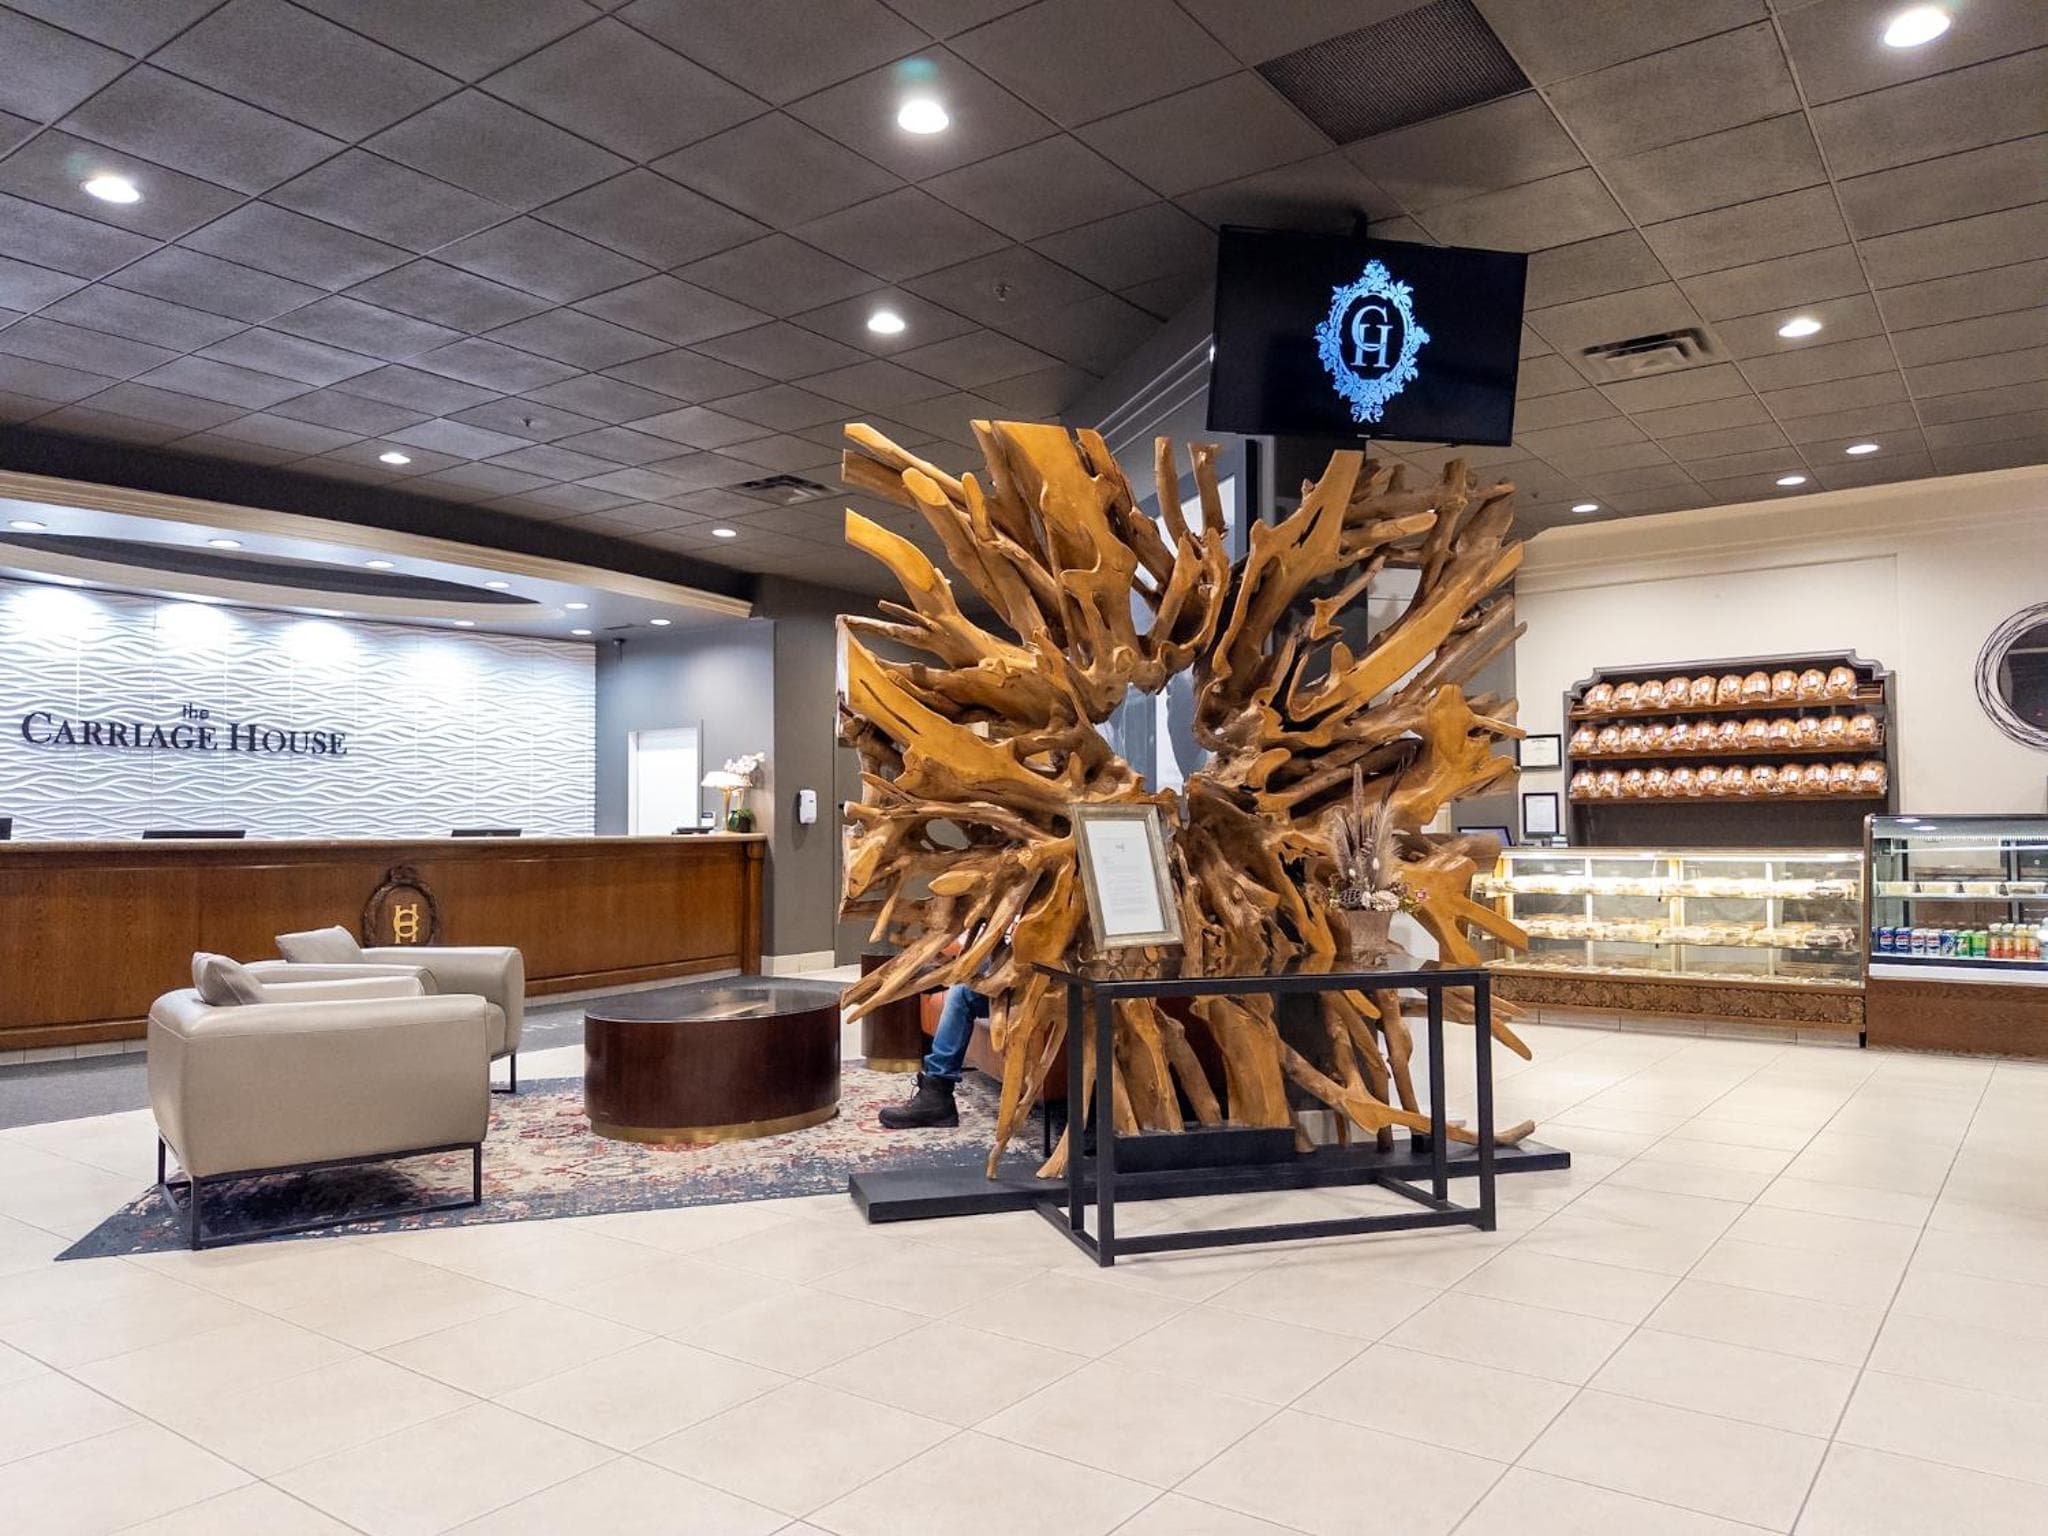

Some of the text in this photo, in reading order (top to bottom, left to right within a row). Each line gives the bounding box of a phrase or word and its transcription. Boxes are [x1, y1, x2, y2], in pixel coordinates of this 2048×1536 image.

[183, 703, 210, 720] the
[21, 711, 348, 755] CARRIAGE HOUSE
